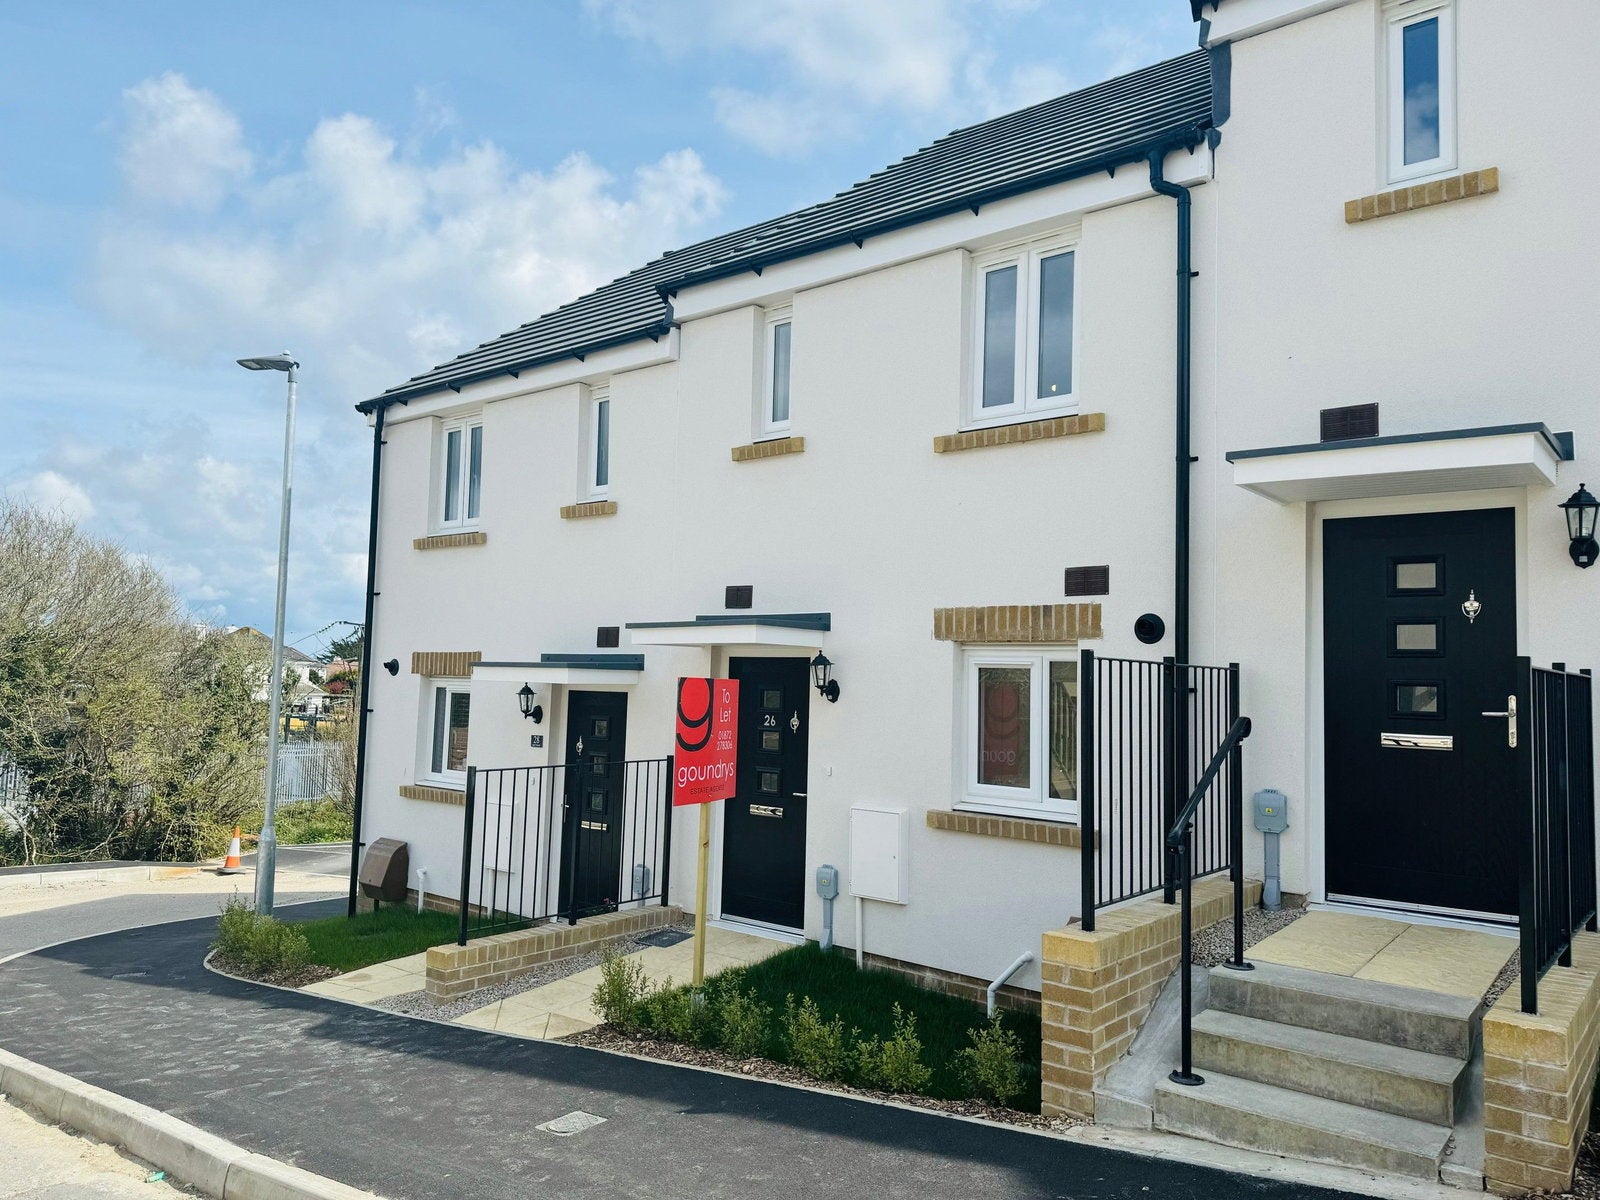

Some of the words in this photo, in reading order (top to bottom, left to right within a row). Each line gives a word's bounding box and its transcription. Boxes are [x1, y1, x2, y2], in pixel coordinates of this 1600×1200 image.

[722, 688, 730, 703] To
[720, 707, 731, 722] Let
[764, 715, 776, 726] 26
[678, 759, 734, 787] goundrys
